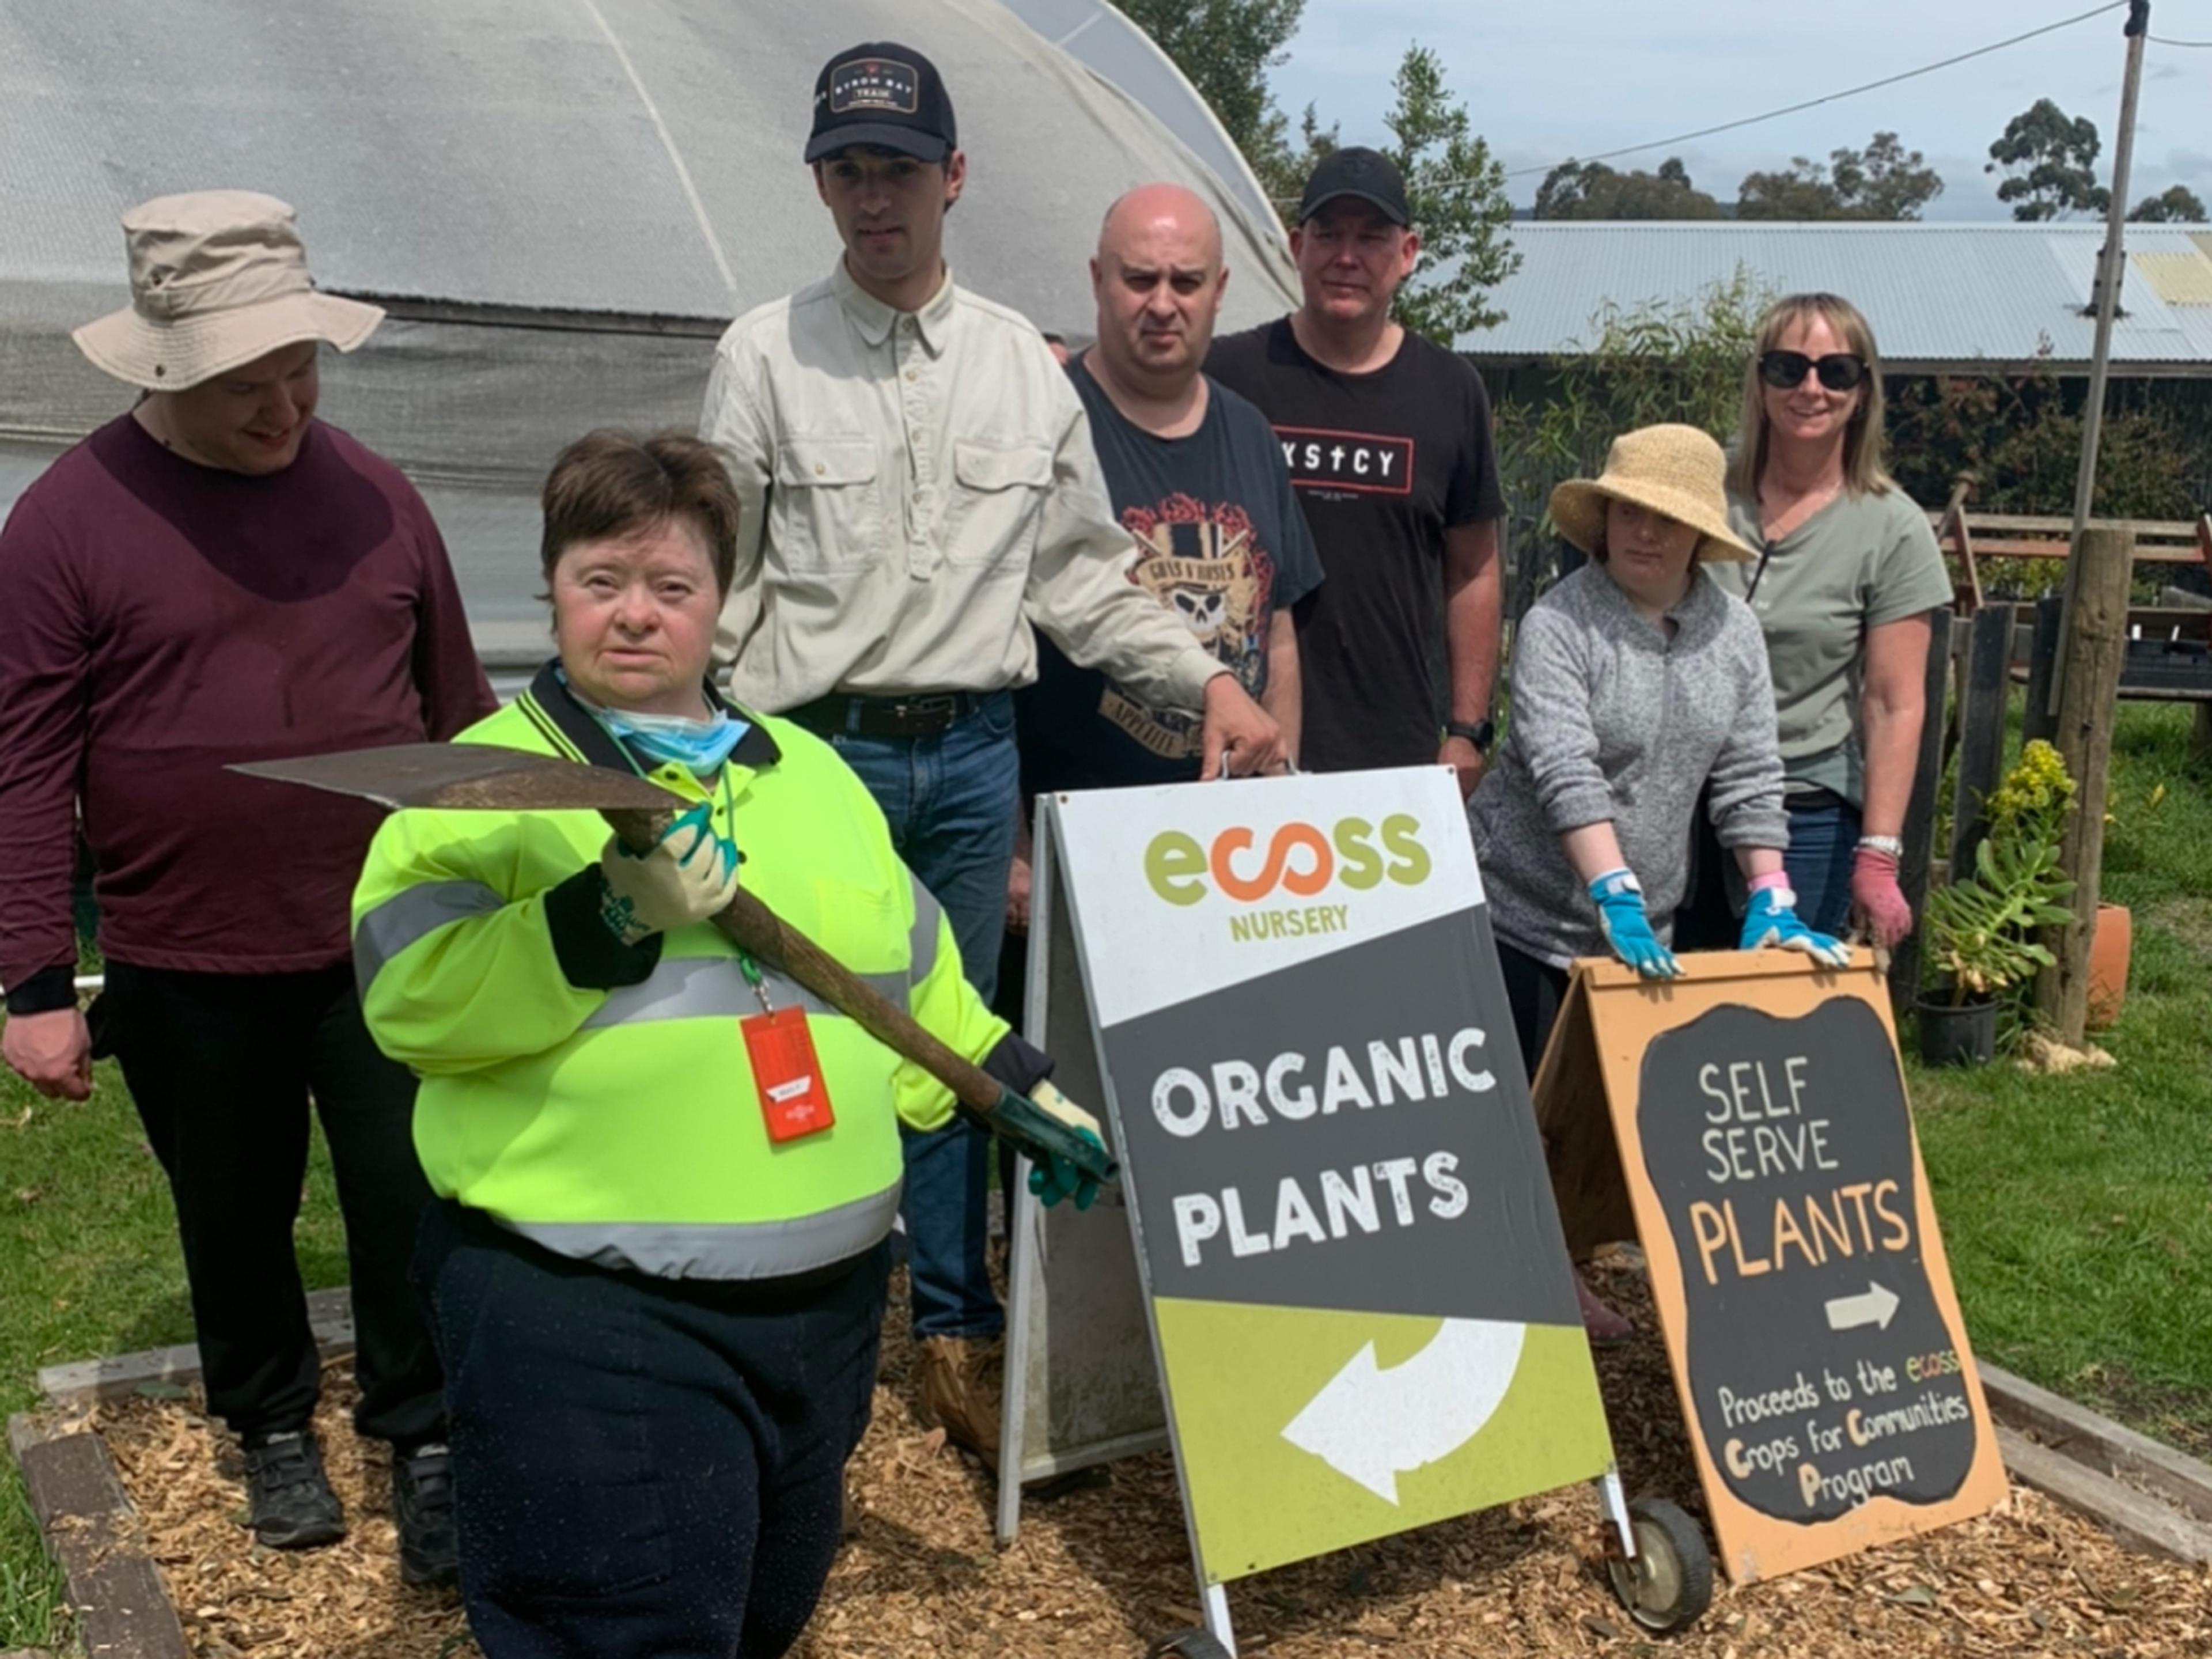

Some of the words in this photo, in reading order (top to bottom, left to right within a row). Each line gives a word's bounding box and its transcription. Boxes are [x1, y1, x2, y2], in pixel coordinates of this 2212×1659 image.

[1144, 813, 1432, 907] ecoss
[1229, 904, 1349, 942] NURSERY
[1152, 1028, 1497, 1137] ORGANIC
[1699, 1056, 1808, 1124] SELF
[1702, 1119, 1839, 1184] SERVE
[1172, 1150, 1469, 1267] PLANTS
[1689, 1179, 1910, 1285] PLANTS
[1718, 1371, 1820, 1428] Proceeds
[1824, 1367, 1852, 1401] to
[1856, 1359, 1898, 1396] the
[1905, 1350, 1963, 1382] ecoss
[1724, 1435, 1800, 1479] Crops
[1798, 1455, 1915, 1509] Program
